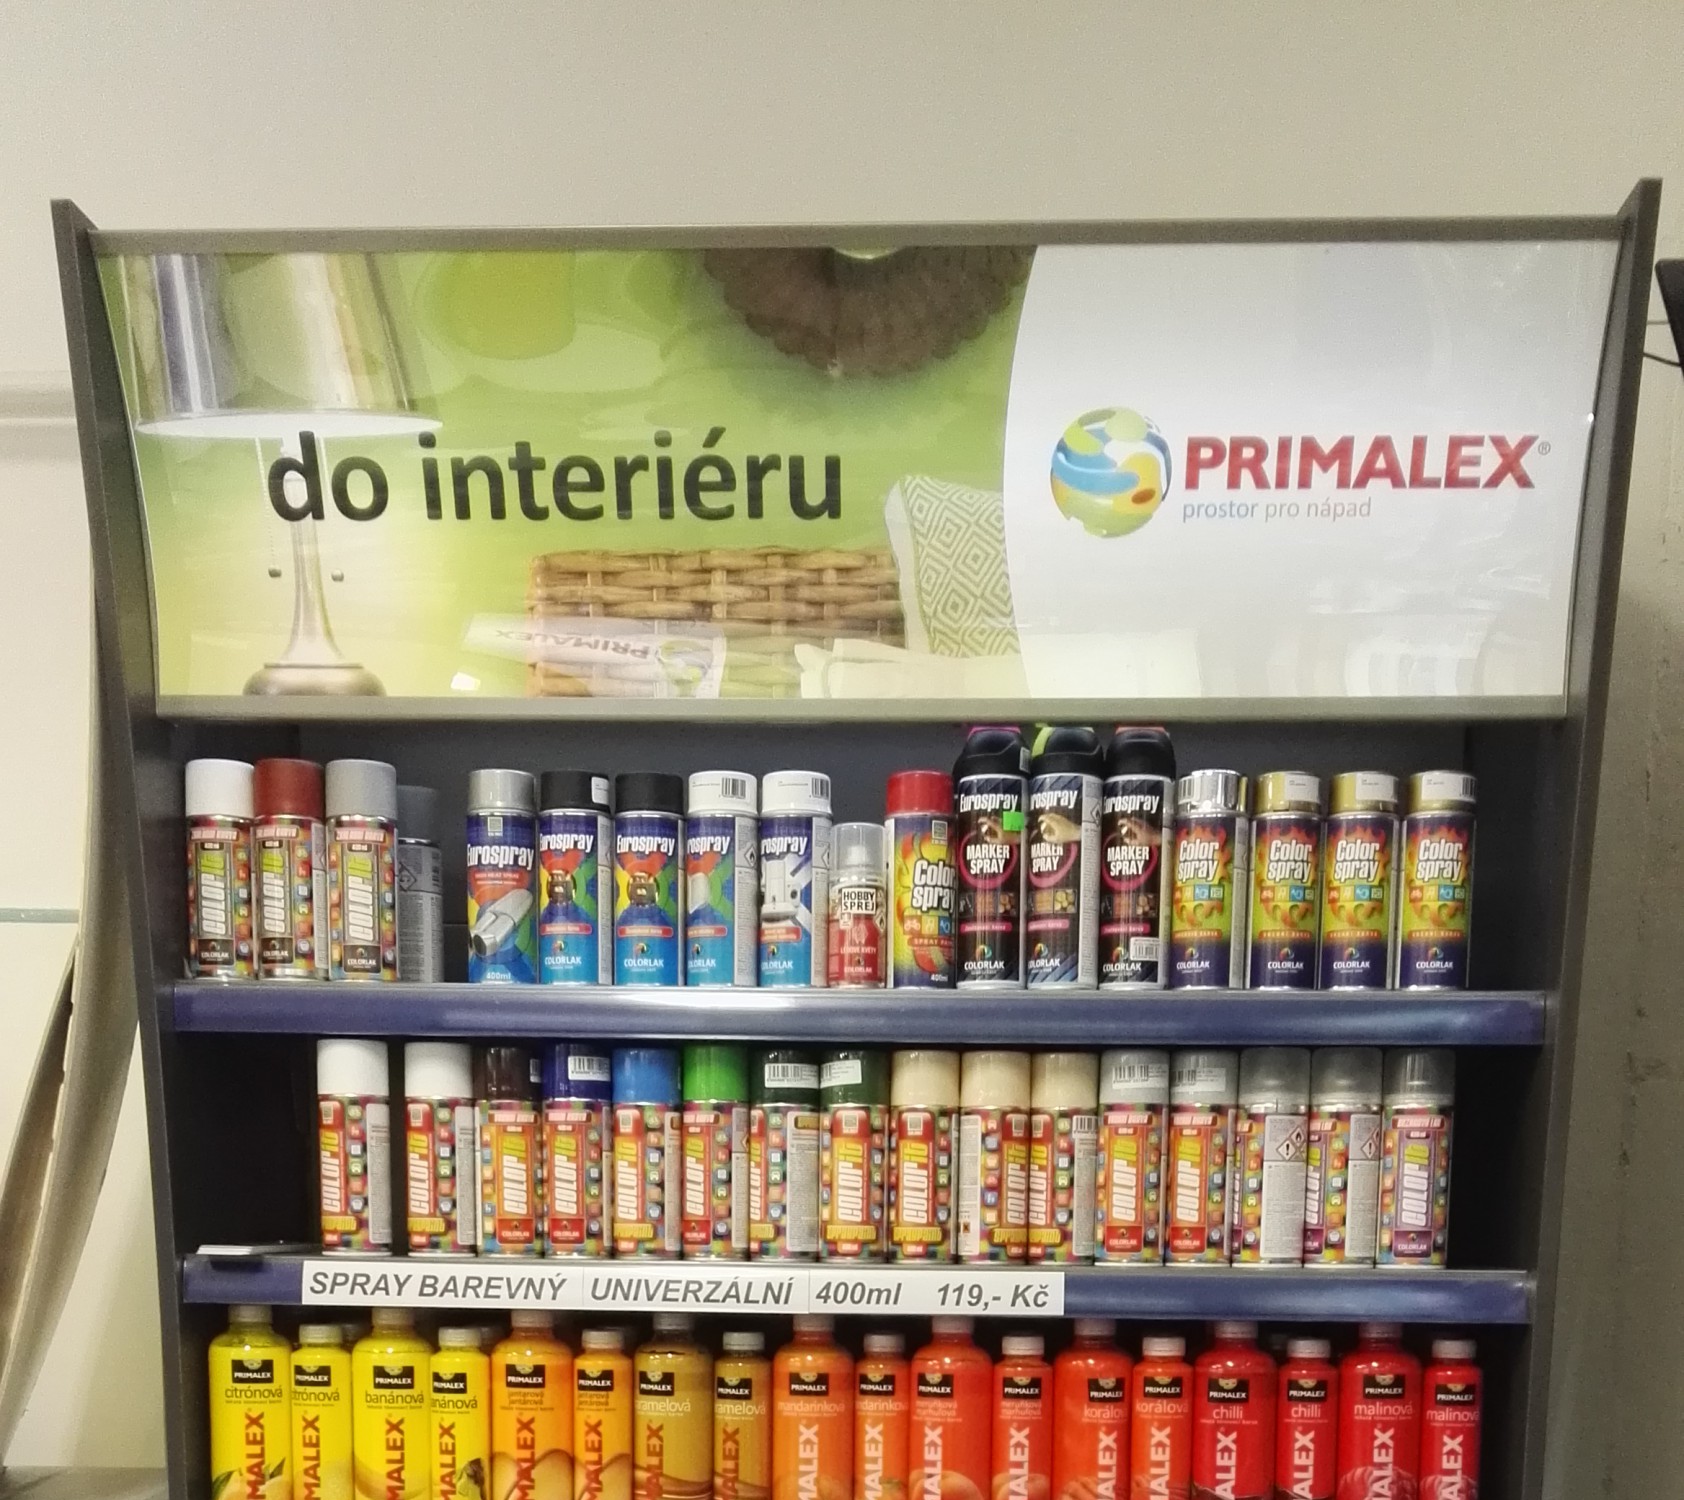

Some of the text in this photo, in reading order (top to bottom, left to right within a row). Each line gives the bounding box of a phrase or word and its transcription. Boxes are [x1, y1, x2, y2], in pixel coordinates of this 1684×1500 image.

[1184, 435, 1539, 491] PRIMALEX
[268, 427, 841, 522] do interiéru
[1182, 497, 1372, 522] prostor pro nápad
[617, 835, 675, 855] Eurospray
[967, 845, 1009, 859] MARKER
[1180, 838, 1219, 861] Color
[1271, 838, 1312, 862] Color
[1337, 839, 1379, 862] Color
[1419, 838, 1462, 861] Color
[467, 844, 534, 870] Eurospray
[1107, 845, 1149, 862] MARKER
[970, 860, 1005, 875] SPRAY
[1032, 857, 1059, 874] SPRAY
[1110, 861, 1144, 877] SPRAY
[1178, 859, 1218, 882] spray
[1268, 860, 1310, 883] spray
[1333, 860, 1379, 883] spray
[1417, 859, 1462, 882] spray
[843, 891, 874, 902] HOBBY
[843, 902, 875, 912] SPREJ
[545, 957, 582, 965] COLORLAK
[624, 959, 664, 968] COLORLAK
[964, 960, 1005, 971] COLORLAK
[1103, 963, 1141, 972] COLORLAK
[1176, 960, 1210, 969] COLORLAK
[1268, 960, 1303, 969] COLORLAK
[1333, 960, 1370, 969] COLORLAK
[1416, 960, 1453, 969] COLORLAK
[310, 1271, 1049, 1310] SPRAY BAREVNÝ UNIVERZÁLNÍ 400ml 119,- Kč
[234, 1371, 271, 1379] PRIMALEX
[225, 1386, 283, 1399] citrónová
[1145, 1386, 1180, 1394] PRIMALEX
[1209, 1391, 1247, 1399] PRIMALEX
[1437, 1393, 1473, 1401] PRIMALEX
[365, 1391, 424, 1404] banánová
[1213, 1406, 1243, 1419] chilli
[1291, 1404, 1321, 1418] chilli
[1354, 1402, 1413, 1415] malinová
